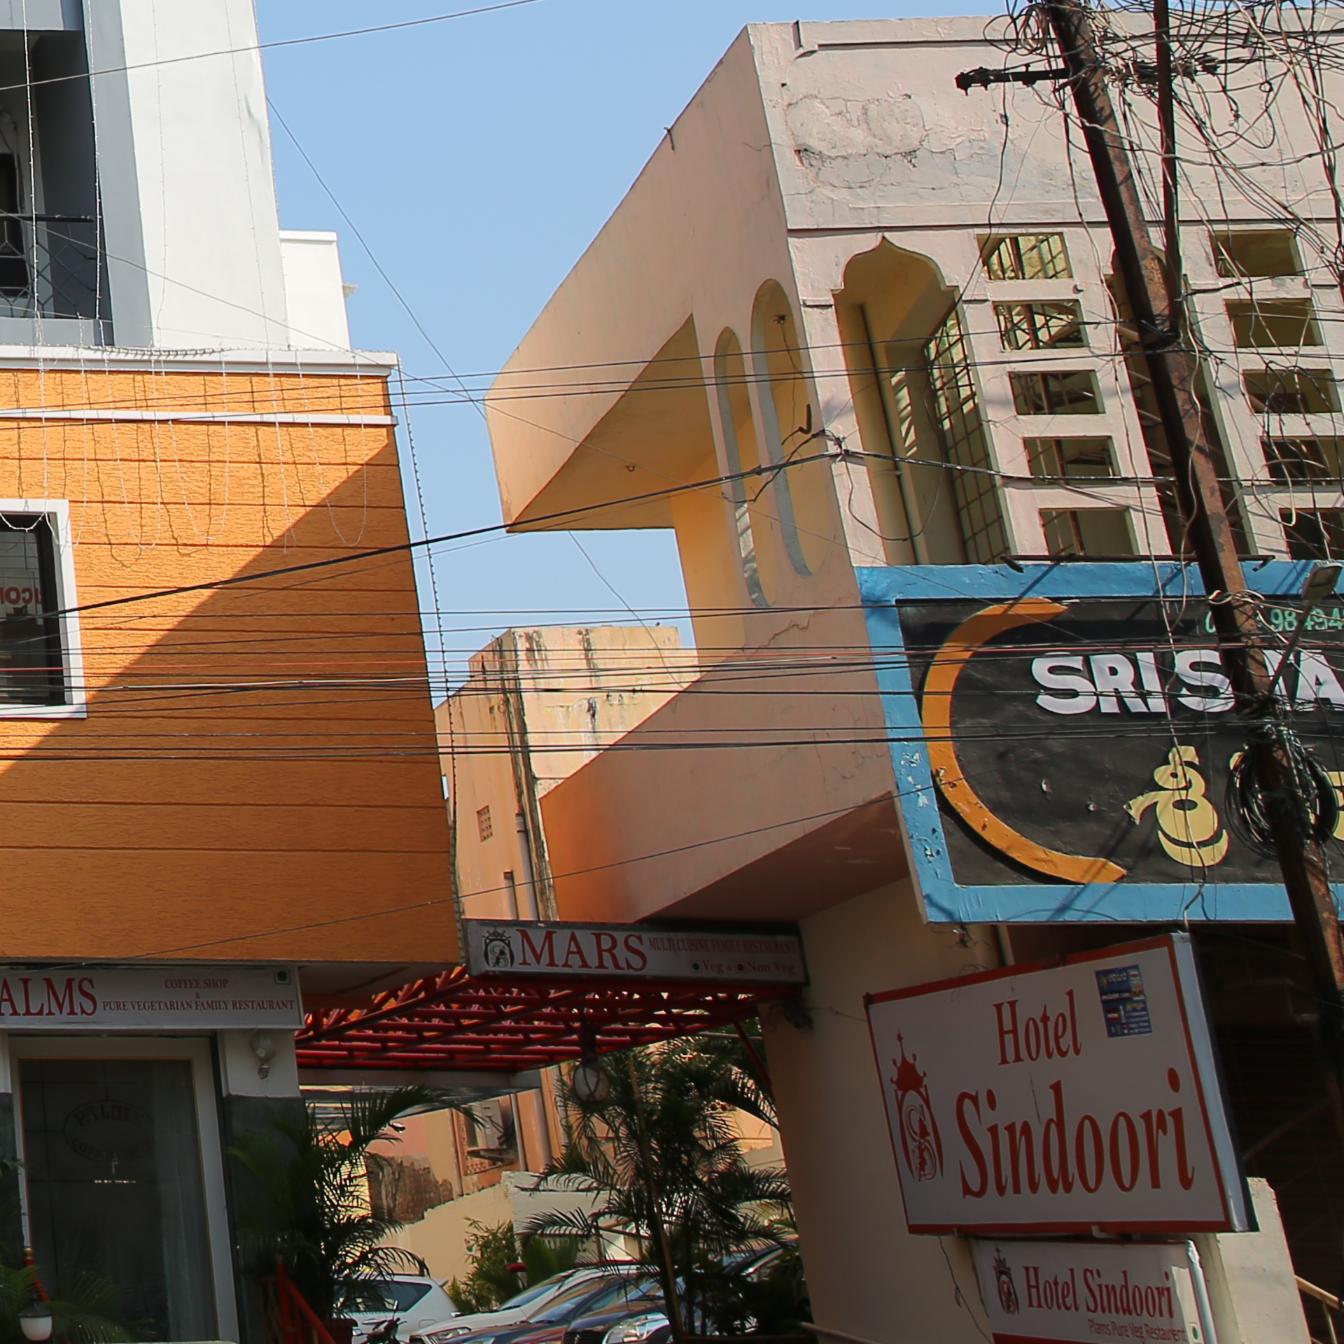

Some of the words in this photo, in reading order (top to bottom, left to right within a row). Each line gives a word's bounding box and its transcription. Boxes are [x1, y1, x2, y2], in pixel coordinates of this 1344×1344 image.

[1031, 652, 1168, 714] SRI
[515, 928, 648, 972] MARS
[102, 1000, 129, 1012] PURE
[130, 1000, 192, 1012] VEGETARIAN
[194, 999, 232, 1011] FAMILY
[232, 999, 295, 1011] RESTAURANT
[203, 978, 229, 989] SHOP
[993, 988, 1082, 1066] Hotel
[955, 1066, 1196, 1200] Sindoori
[1022, 1265, 1080, 1313] Hotel
[1082, 1266, 1175, 1319] Sindoori
